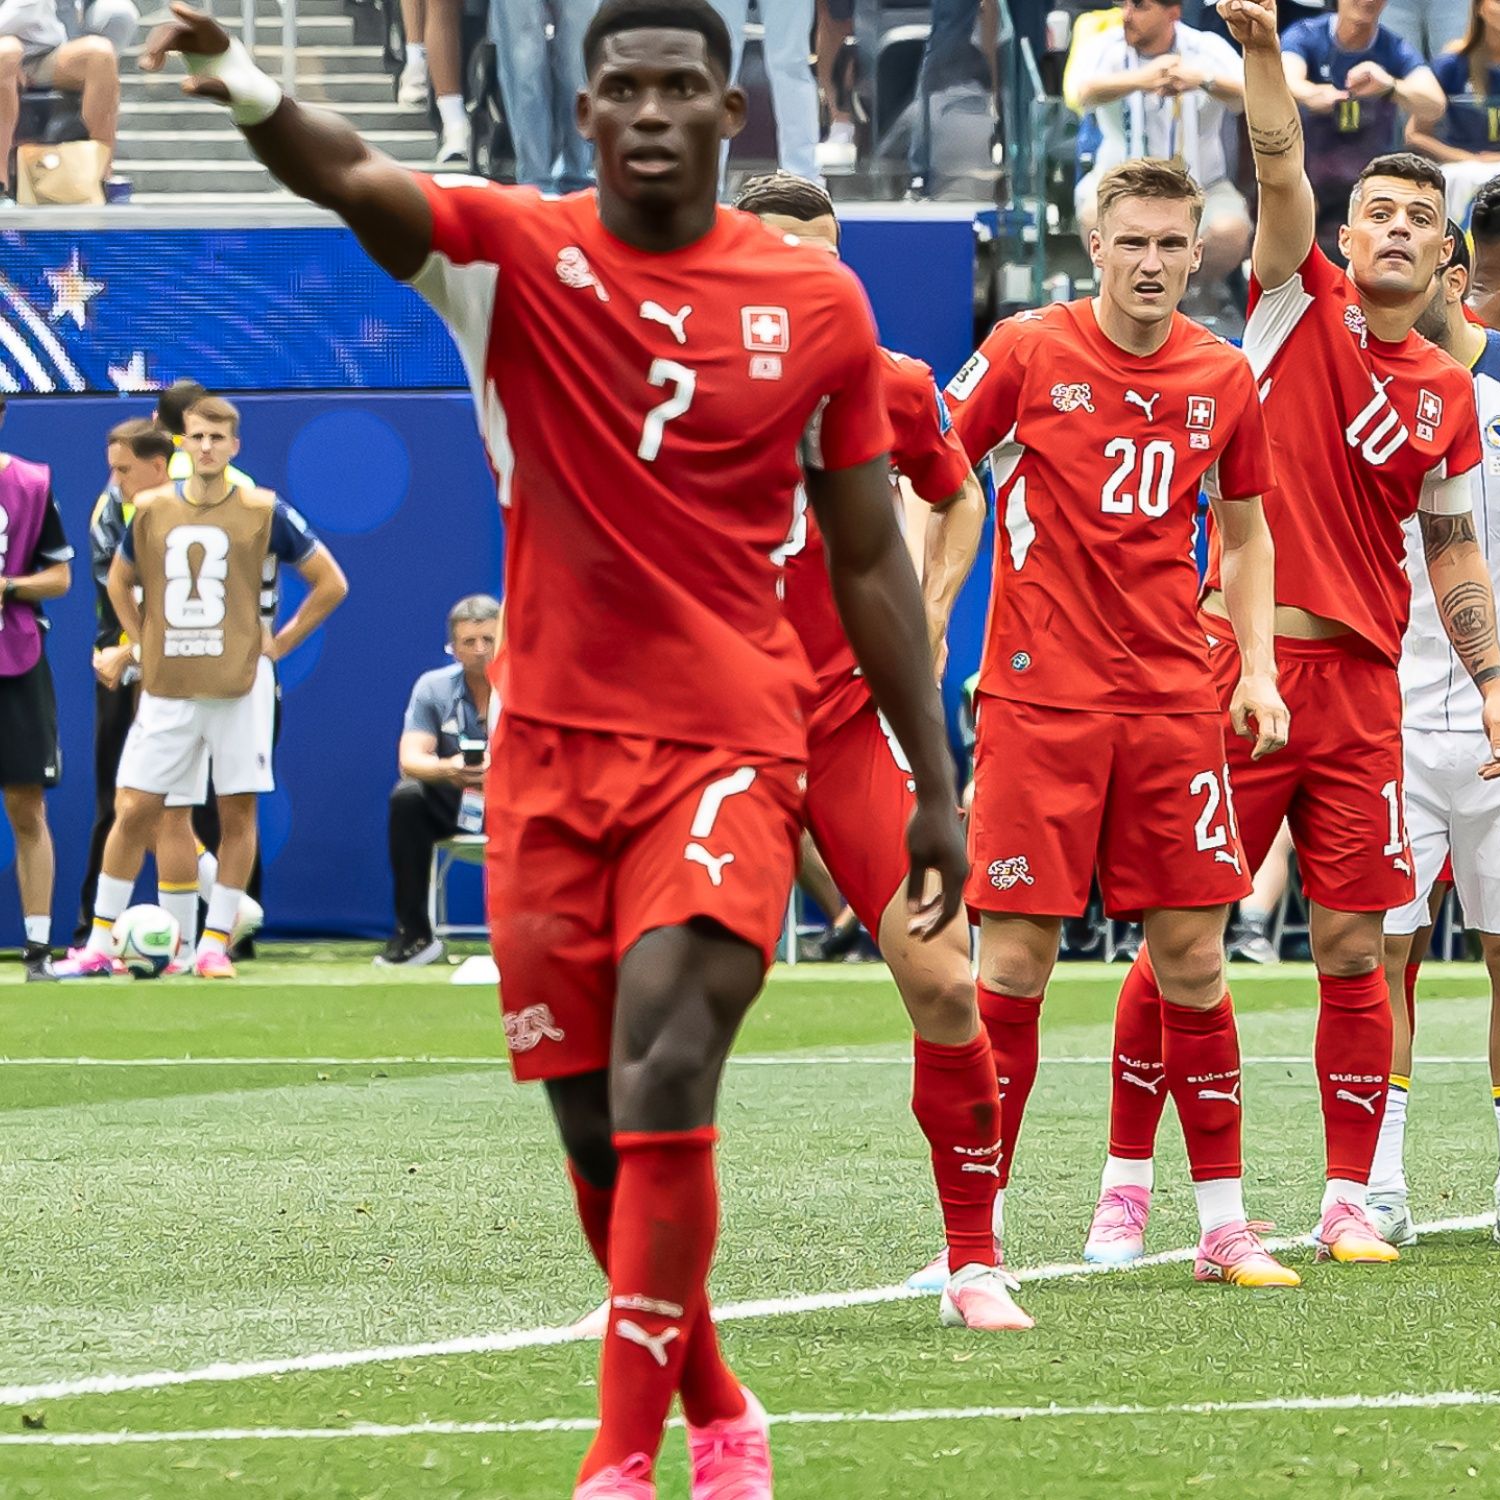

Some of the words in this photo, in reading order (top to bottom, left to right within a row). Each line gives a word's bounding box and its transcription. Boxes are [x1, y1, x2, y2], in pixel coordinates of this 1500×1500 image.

[637, 358, 698, 462] 7
[1100, 436, 1177, 519] 20
[1380, 779, 1409, 857] 1
[1329, 1073, 1383, 1083] suisse
